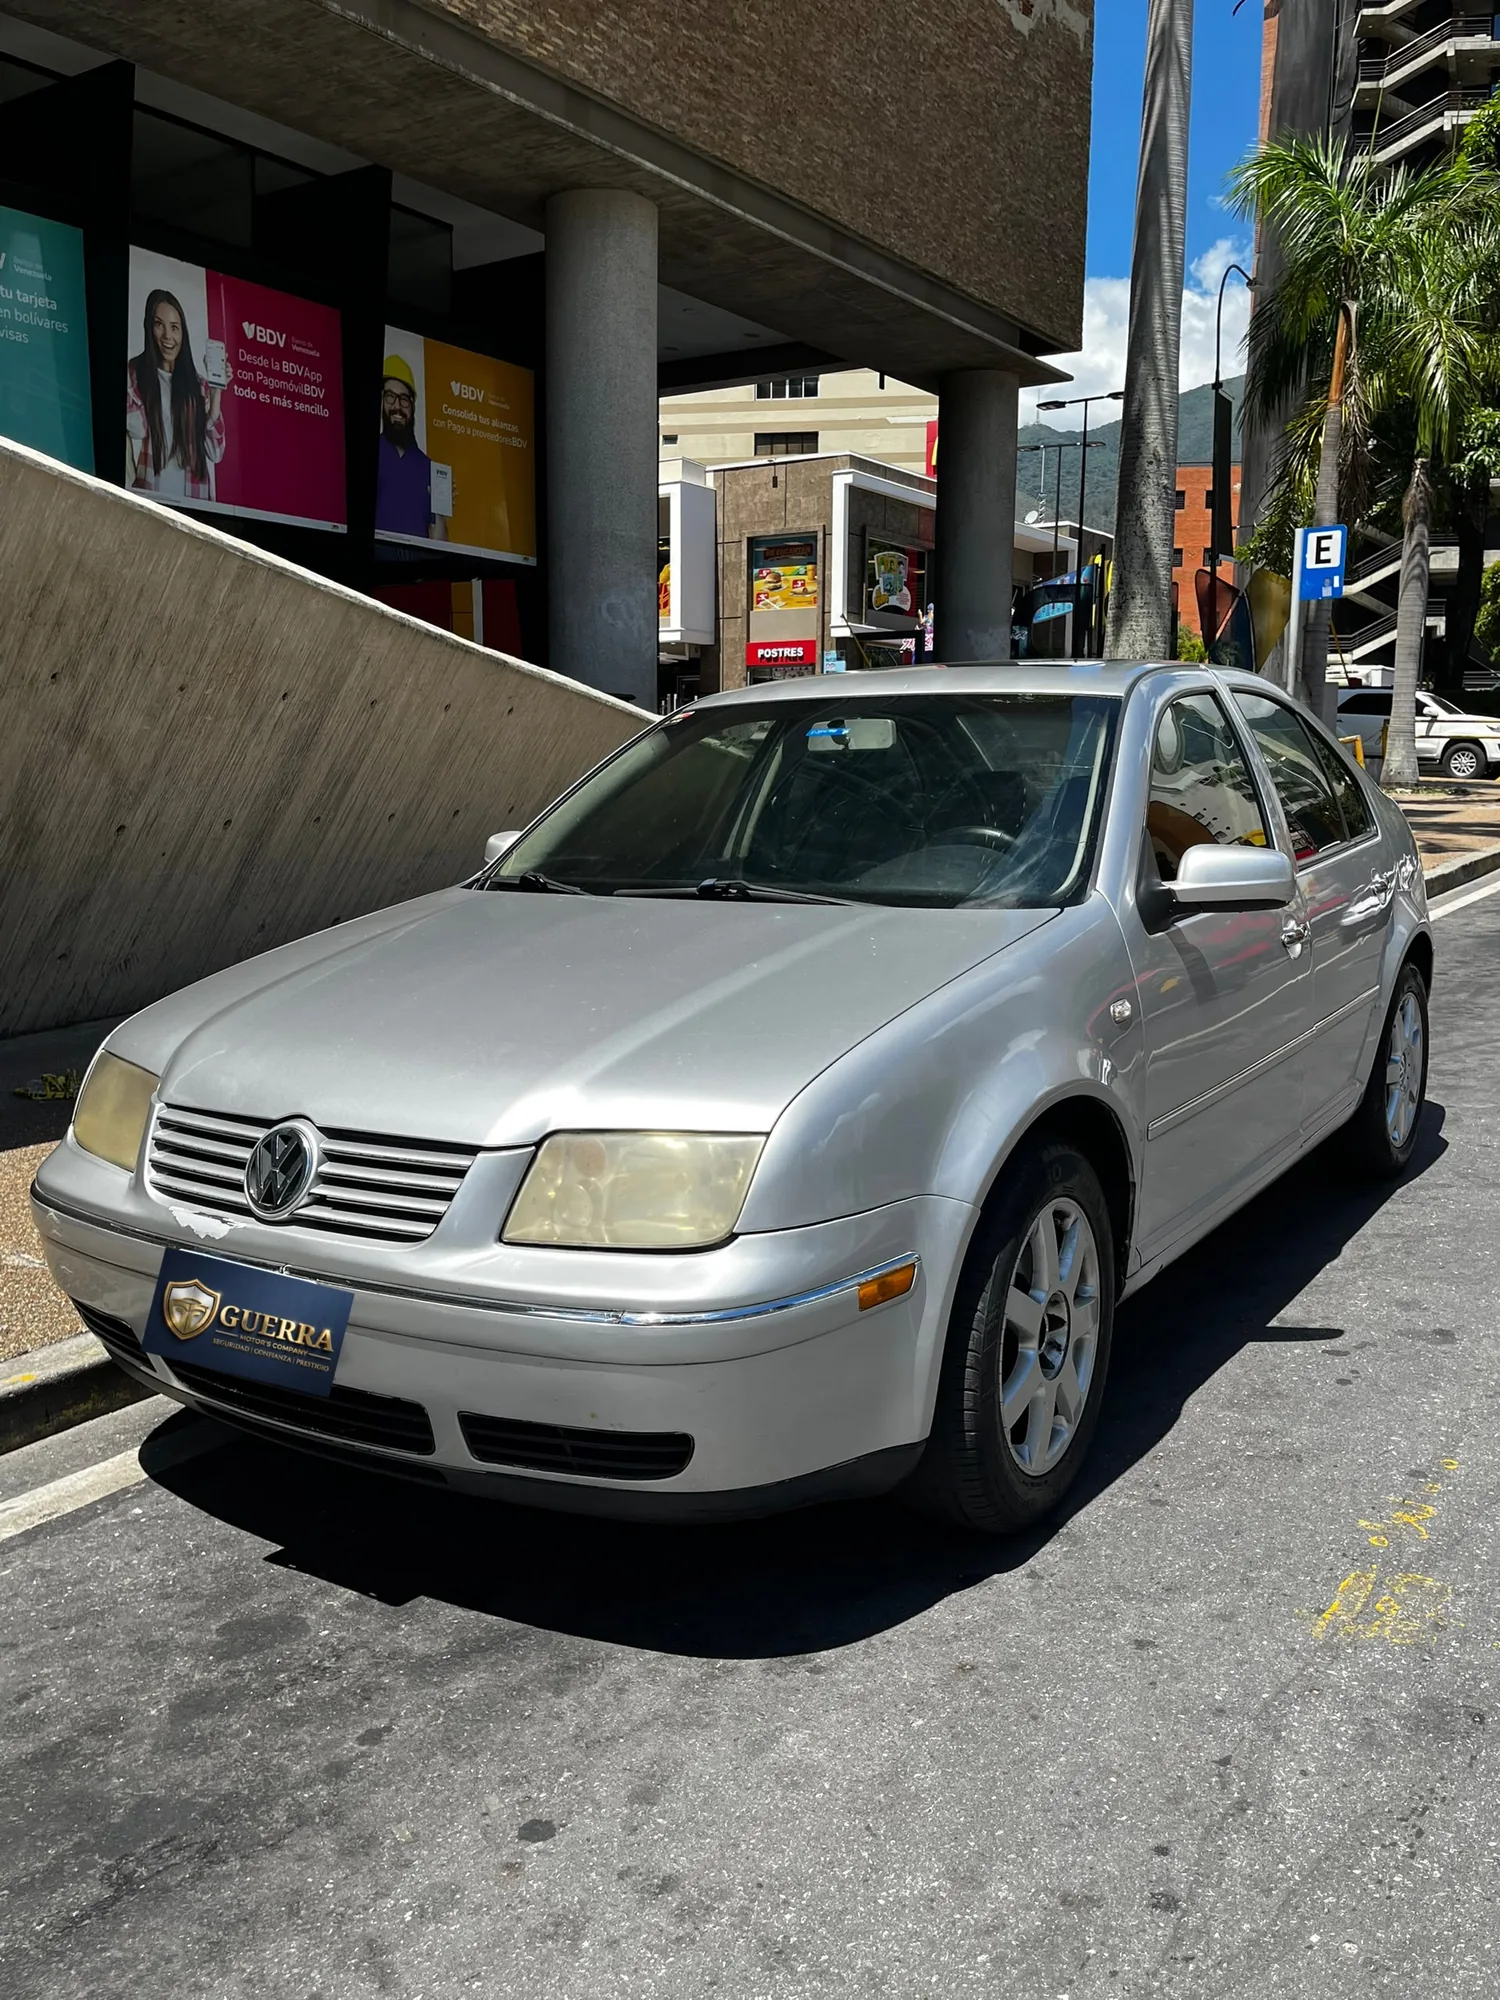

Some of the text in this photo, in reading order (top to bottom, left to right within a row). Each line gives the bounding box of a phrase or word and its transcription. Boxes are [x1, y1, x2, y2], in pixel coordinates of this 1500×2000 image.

[16, 289, 57, 310] tarjeta
[14, 308, 69, 333] bolívares
[256, 325, 286, 348] BDV
[238, 349, 269, 368] Desde
[271, 358, 280, 371] la
[237, 369, 254, 381] con
[233, 384, 329, 417] todo es más sencillo
[461, 384, 484, 402] BDV
[433, 419, 446, 428] con
[447, 419, 465, 434] Pago
[466, 427, 471, 435] a
[442, 404, 478, 422] Consolida
[479, 415, 490, 426] tus
[491, 418, 519, 433] alianzas
[1315, 535, 1333, 565] E
[757, 647, 804, 659] POSTRES
[219, 1305, 335, 1353] GUERRA
[212, 1338, 330, 1372] SEGURIDAD CONFIANZA PRESTIGIO
[240, 1335, 309, 1357] MOTOR'S COMPANY
